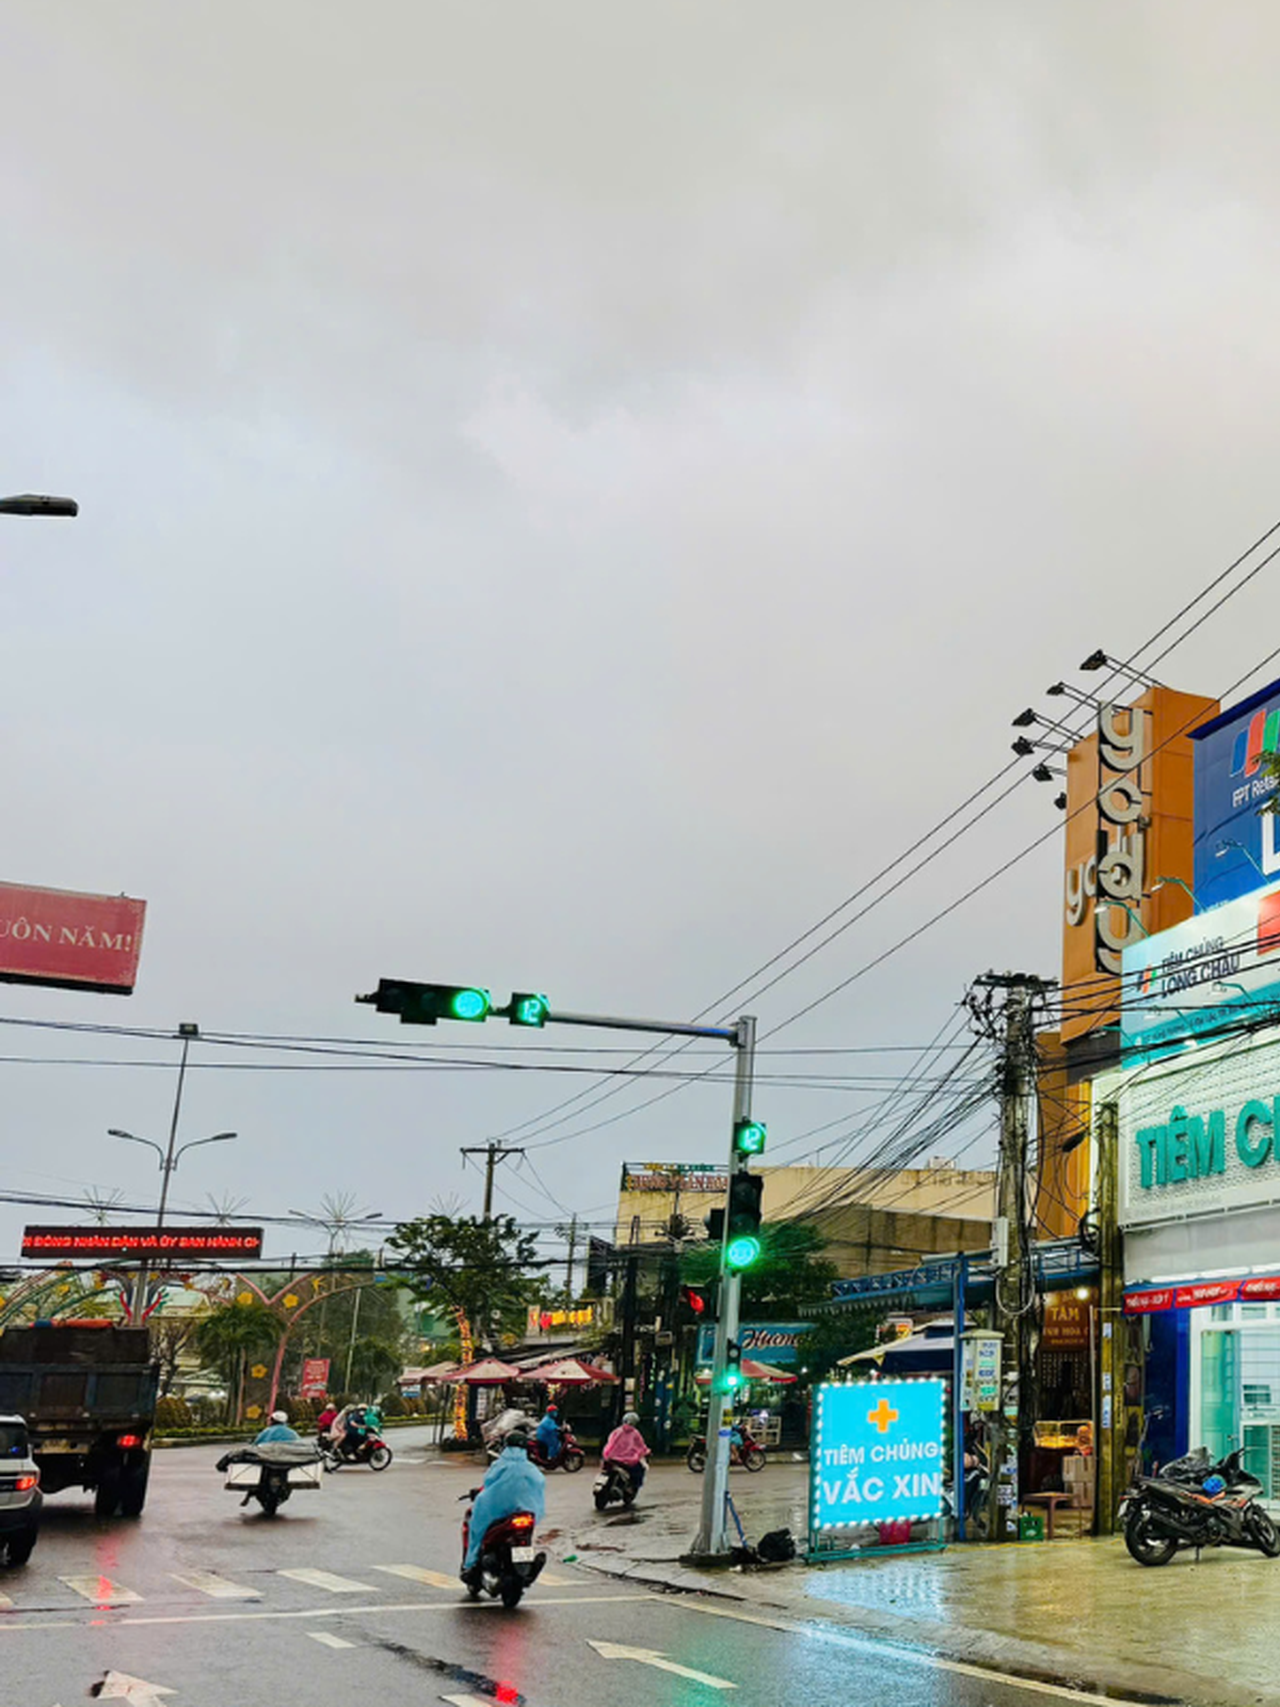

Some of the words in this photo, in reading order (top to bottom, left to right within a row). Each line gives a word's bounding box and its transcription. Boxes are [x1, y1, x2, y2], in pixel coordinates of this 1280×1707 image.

[58, 925, 133, 952] NĂM!
[1161, 968, 1198, 998] LONG
[522, 1000, 541, 1022] 12
[1135, 1105, 1226, 1188] TIÊM
[823, 1444, 865, 1466] TIÊM
[870, 1438, 939, 1463] CHỦNG
[822, 1467, 885, 1505] VẮC
[892, 1472, 941, 1499] XIN
